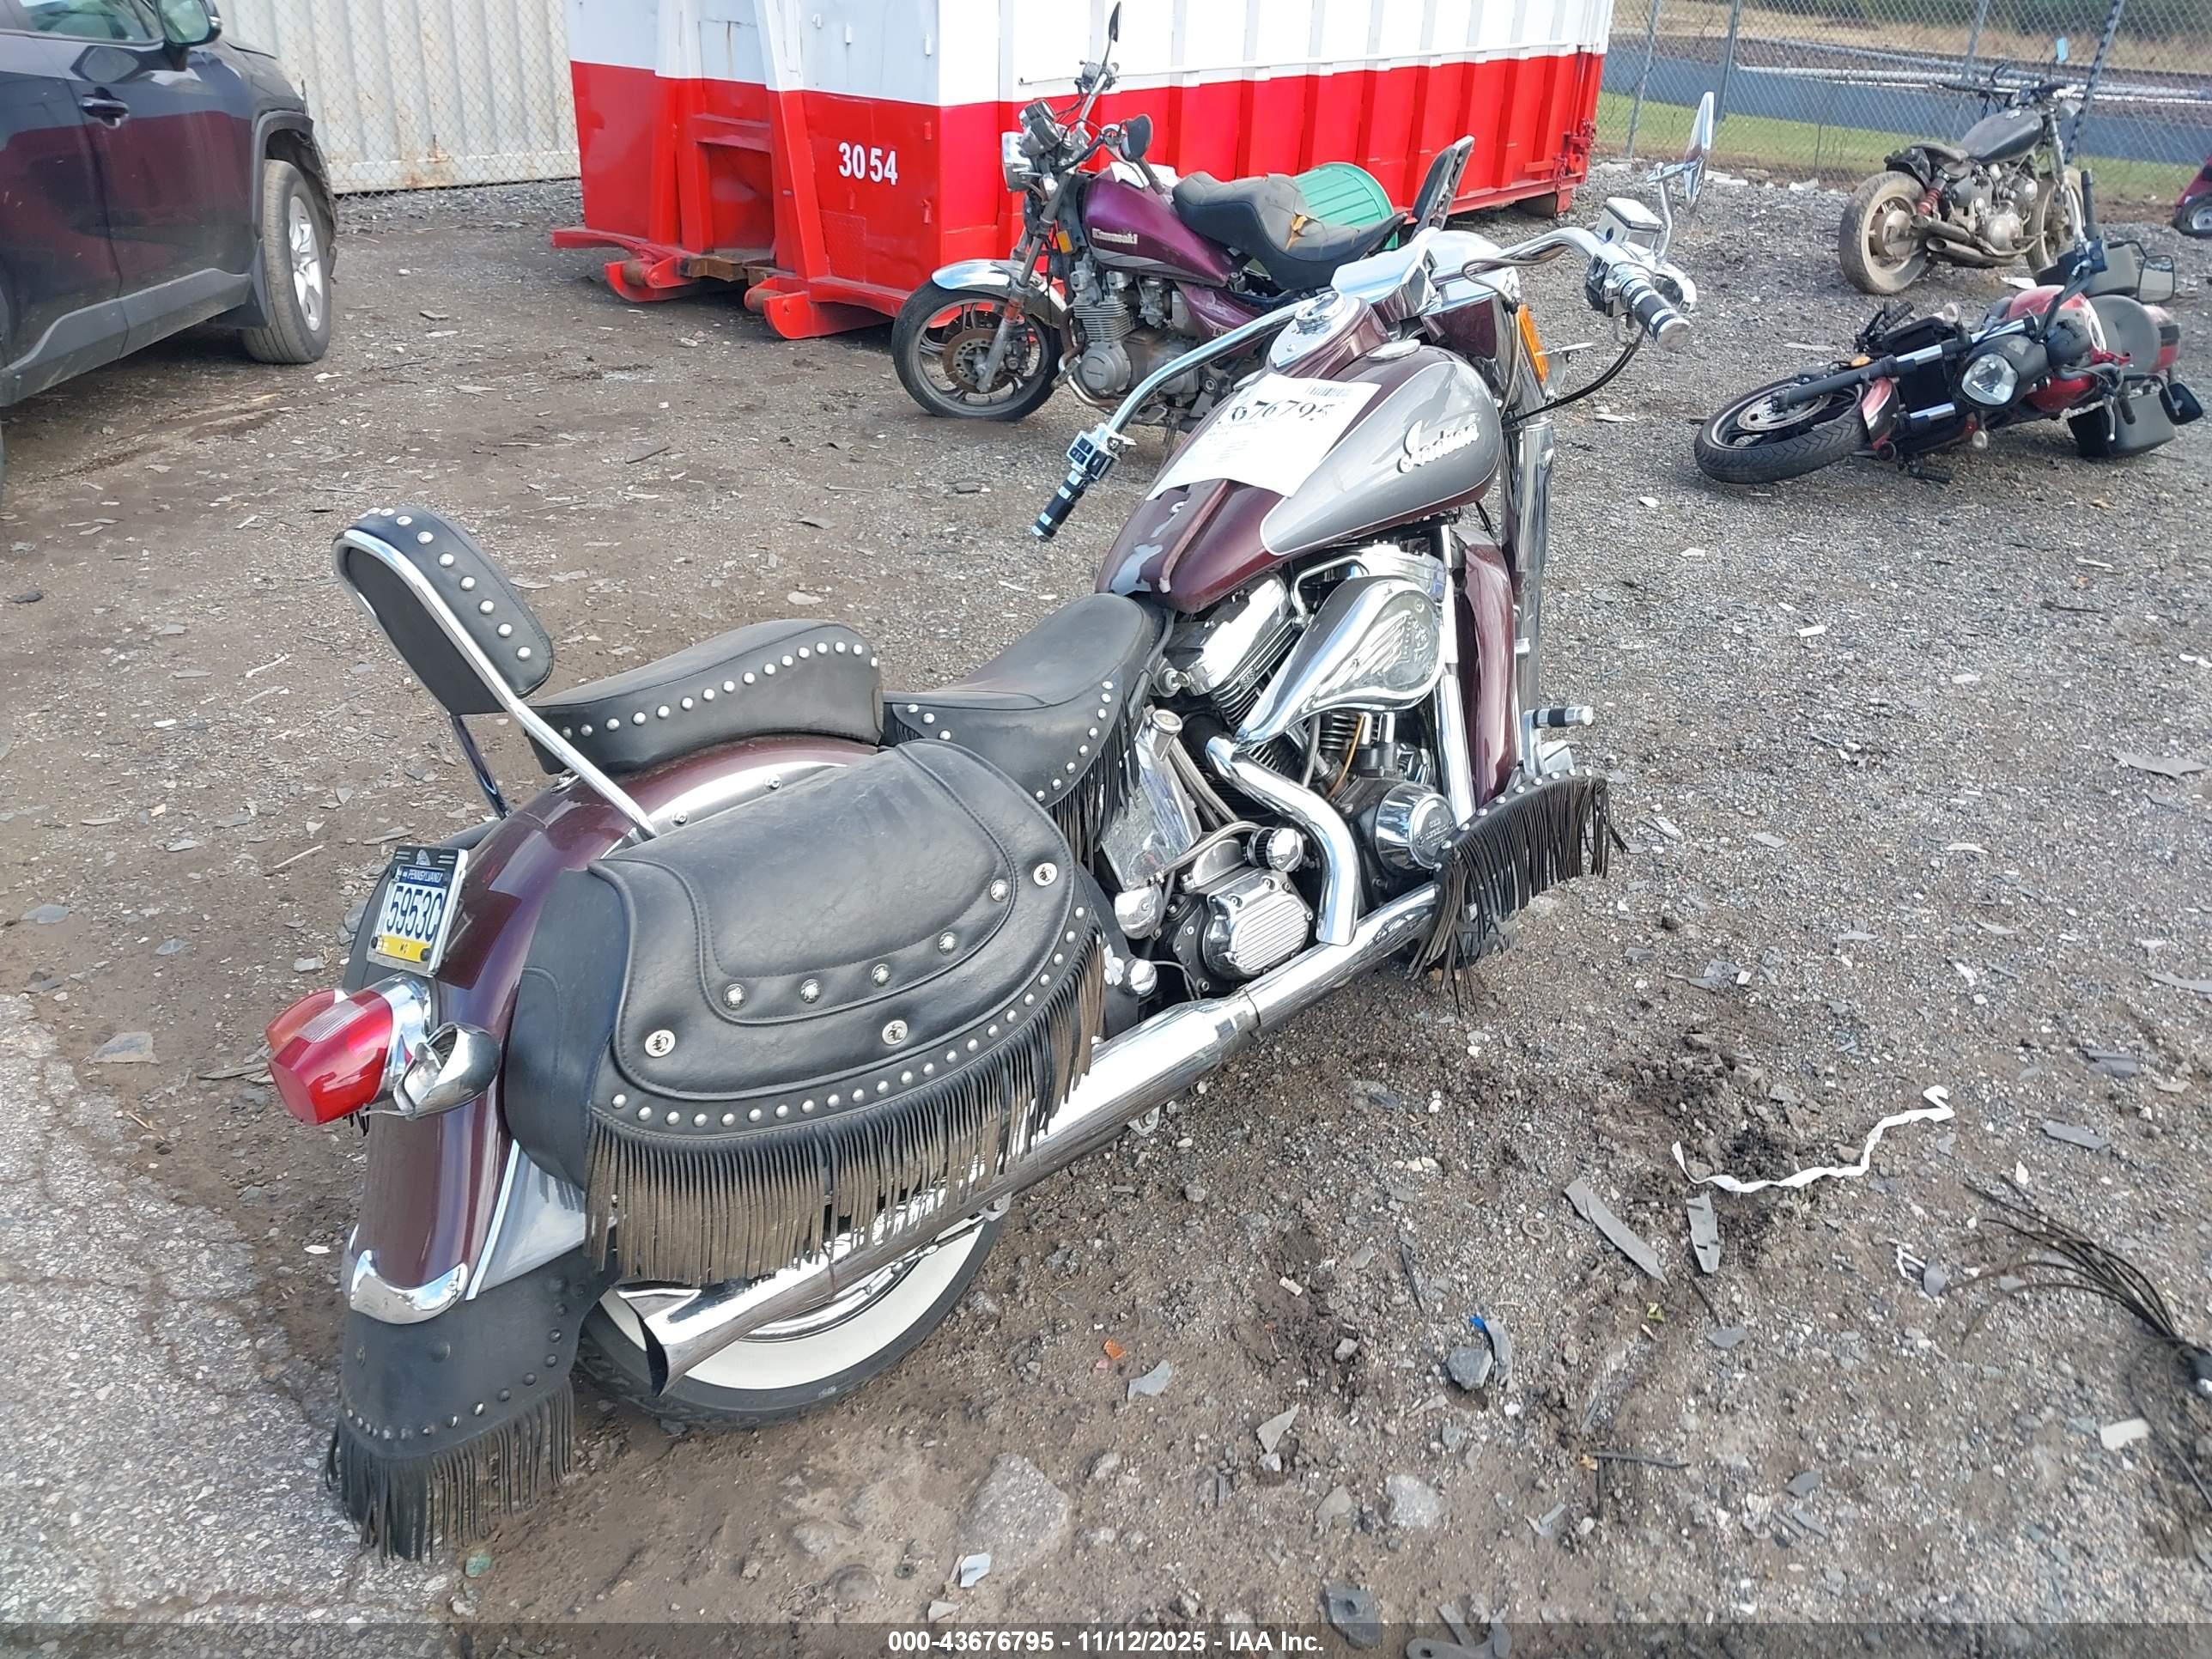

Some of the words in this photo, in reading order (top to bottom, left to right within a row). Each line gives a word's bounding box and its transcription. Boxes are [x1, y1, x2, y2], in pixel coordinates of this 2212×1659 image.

[838, 142, 898, 186] 3054
[1091, 227, 1139, 246] Kawasaki
[1396, 418, 1480, 474] Indian
